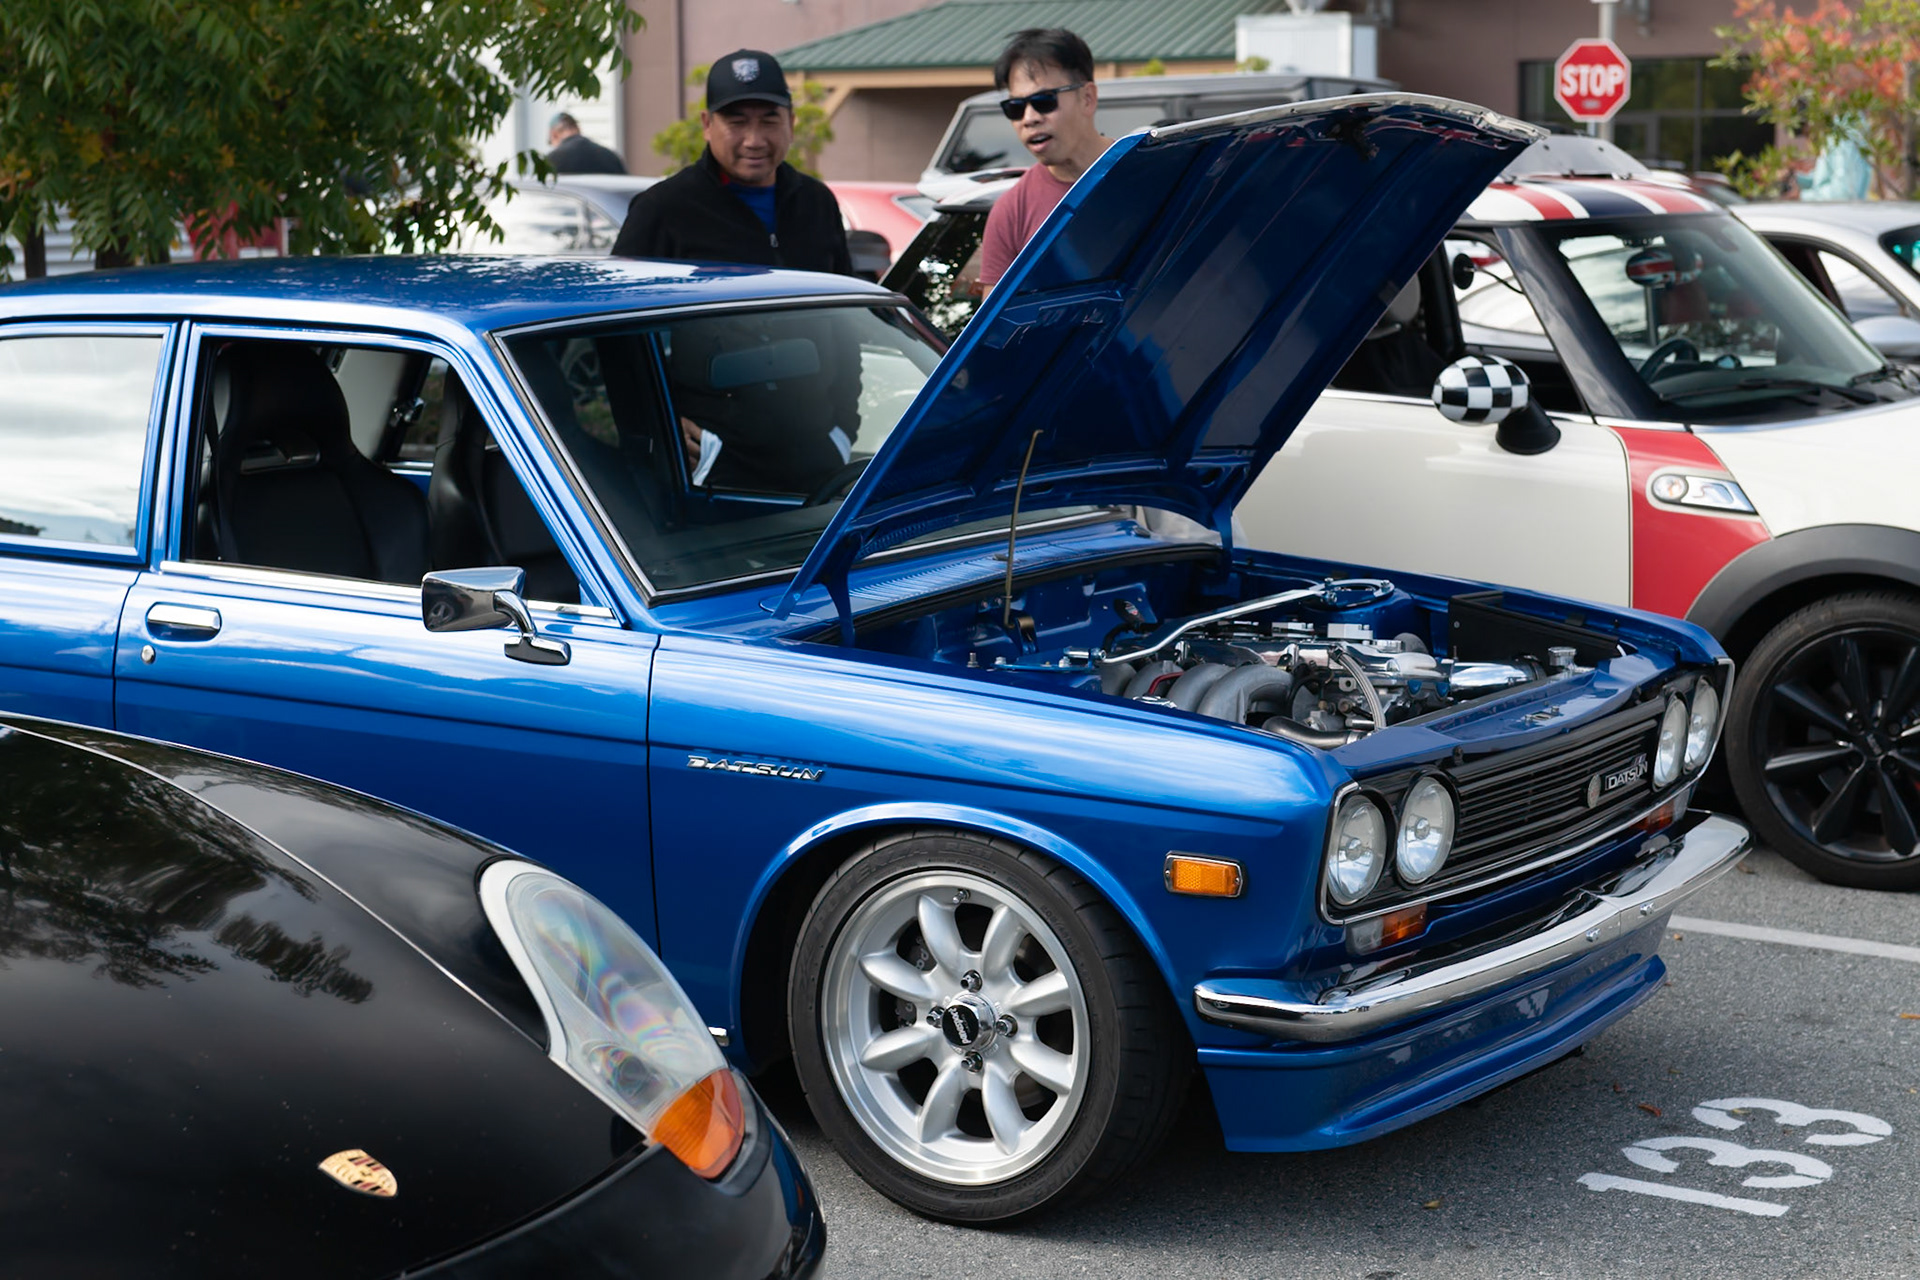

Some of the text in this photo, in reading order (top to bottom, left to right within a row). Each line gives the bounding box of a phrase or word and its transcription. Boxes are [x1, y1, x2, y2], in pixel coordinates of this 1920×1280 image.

[1561, 64, 1625, 97] STOP
[686, 754, 824, 781] DATSUN
[1608, 761, 1649, 790] DATSUN
[1576, 1097, 1893, 1217] 133
